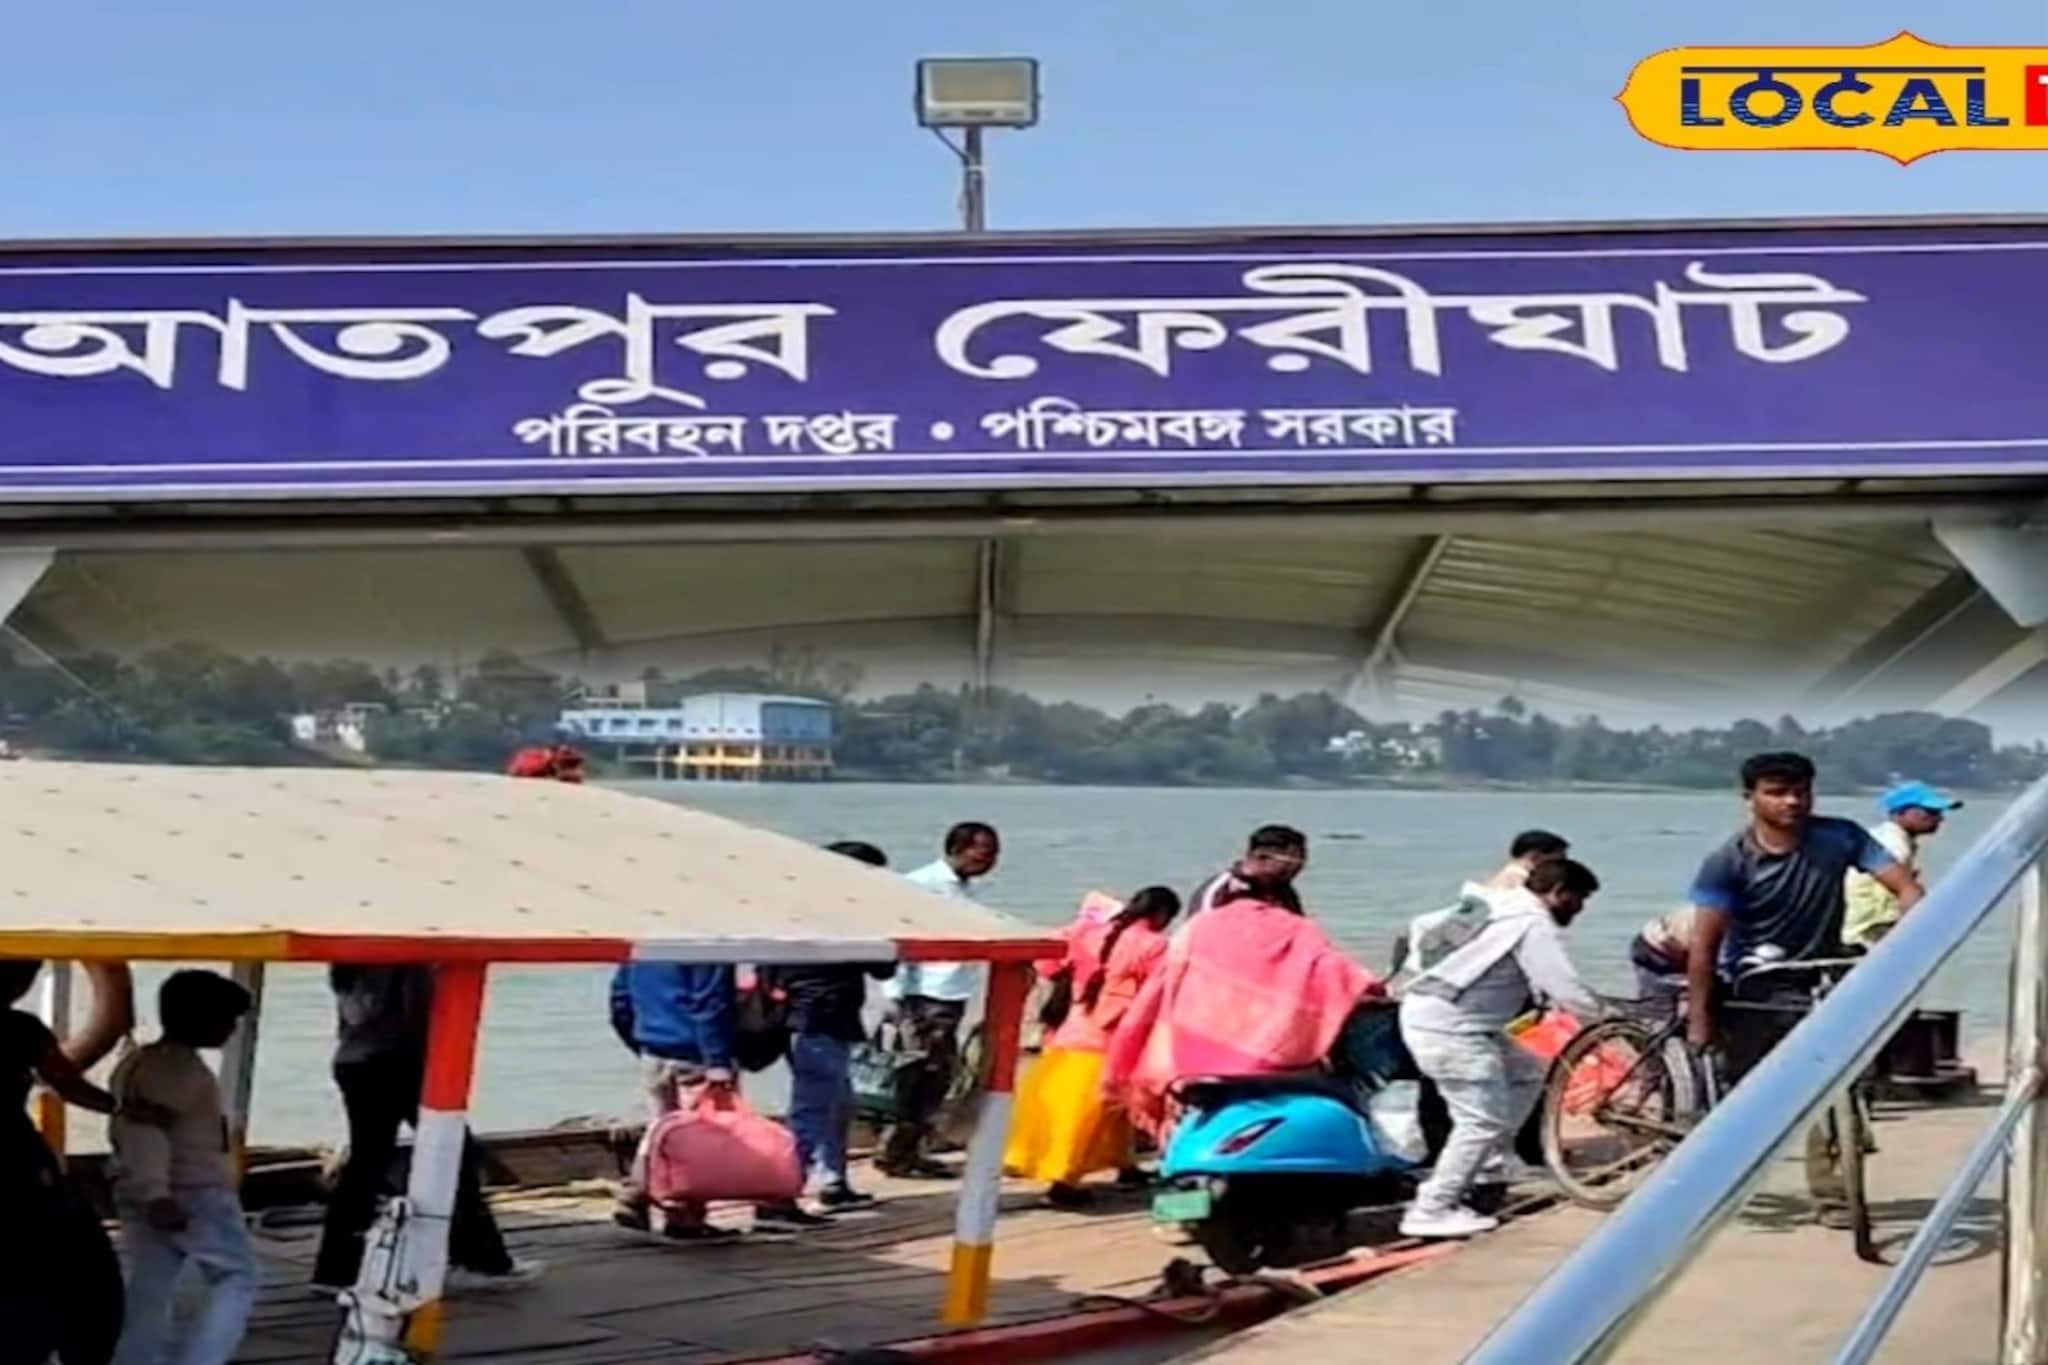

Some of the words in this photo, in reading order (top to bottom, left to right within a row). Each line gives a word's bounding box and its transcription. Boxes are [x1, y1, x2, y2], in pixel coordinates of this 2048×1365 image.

[0, 292, 835, 410] আতপুর
[936, 261, 1867, 379] ফেরীঘাট
[513, 403, 747, 457] পরিবহন
[763, 410, 898, 454] দপ্তর
[980, 396, 1247, 449] পশ্চিমবঙ্গ
[1259, 403, 1458, 446] সরকার
